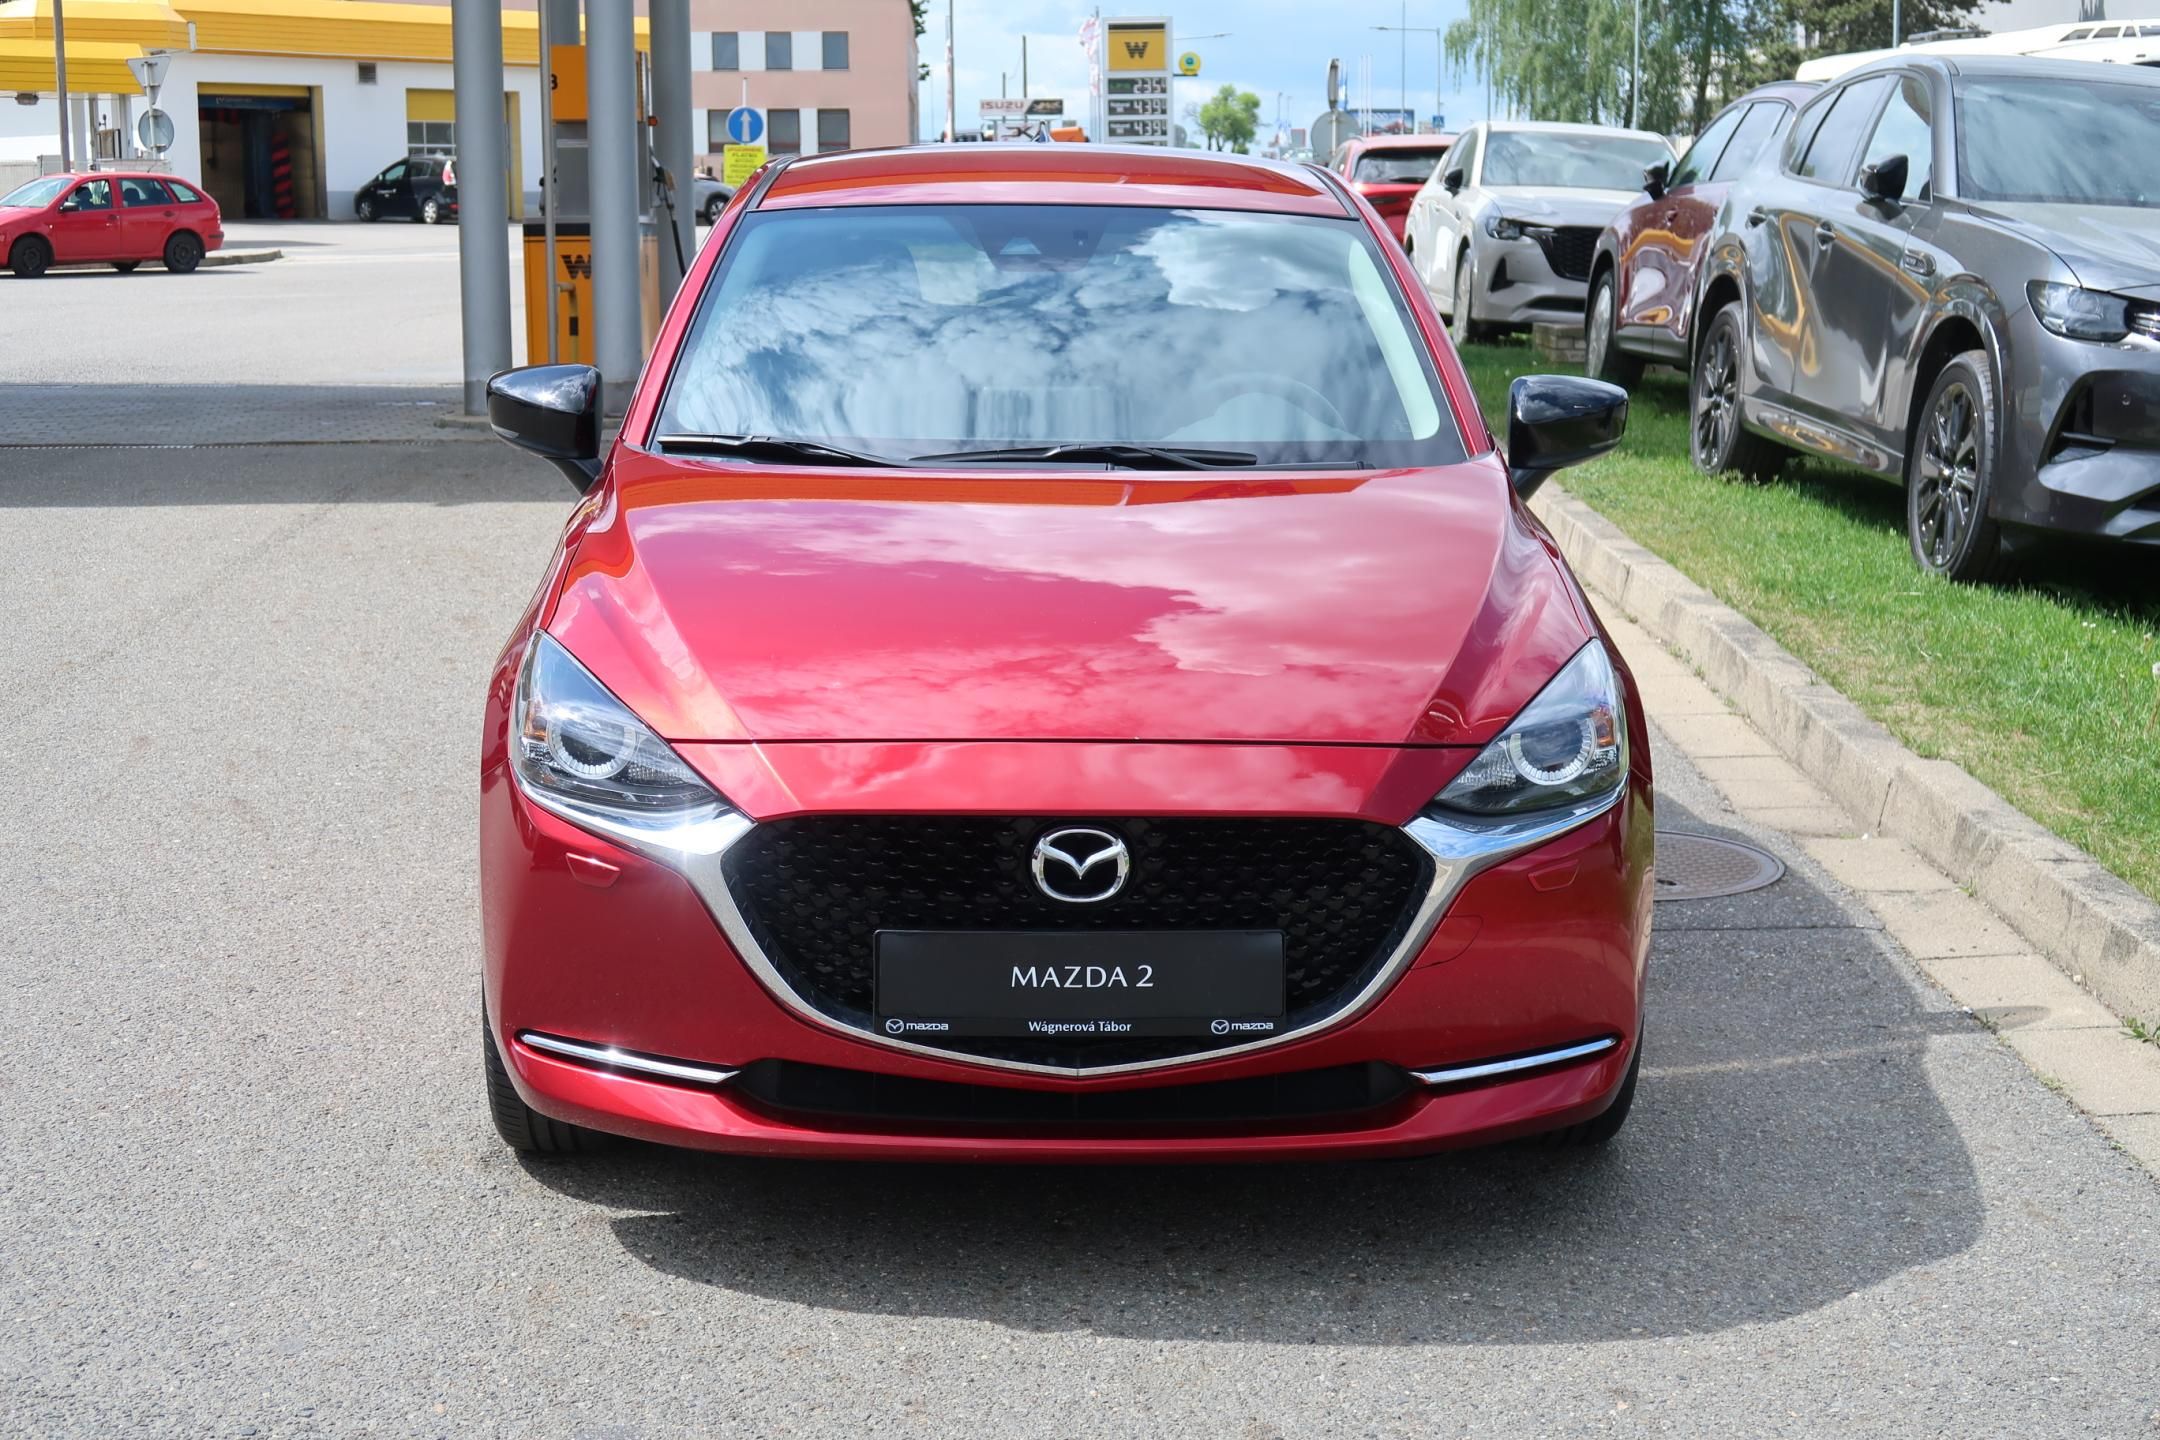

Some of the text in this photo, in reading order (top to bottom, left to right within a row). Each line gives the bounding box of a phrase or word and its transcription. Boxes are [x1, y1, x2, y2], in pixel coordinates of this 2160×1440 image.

[1124, 41, 1149, 59] W
[981, 101, 1024, 110] ISUZU
[1011, 965, 1154, 988] MAZDA 2
[906, 1022, 949, 1031] mazda
[1028, 1020, 1132, 1034] Wágnerová Tábor
[1231, 1022, 1274, 1031] mazda
